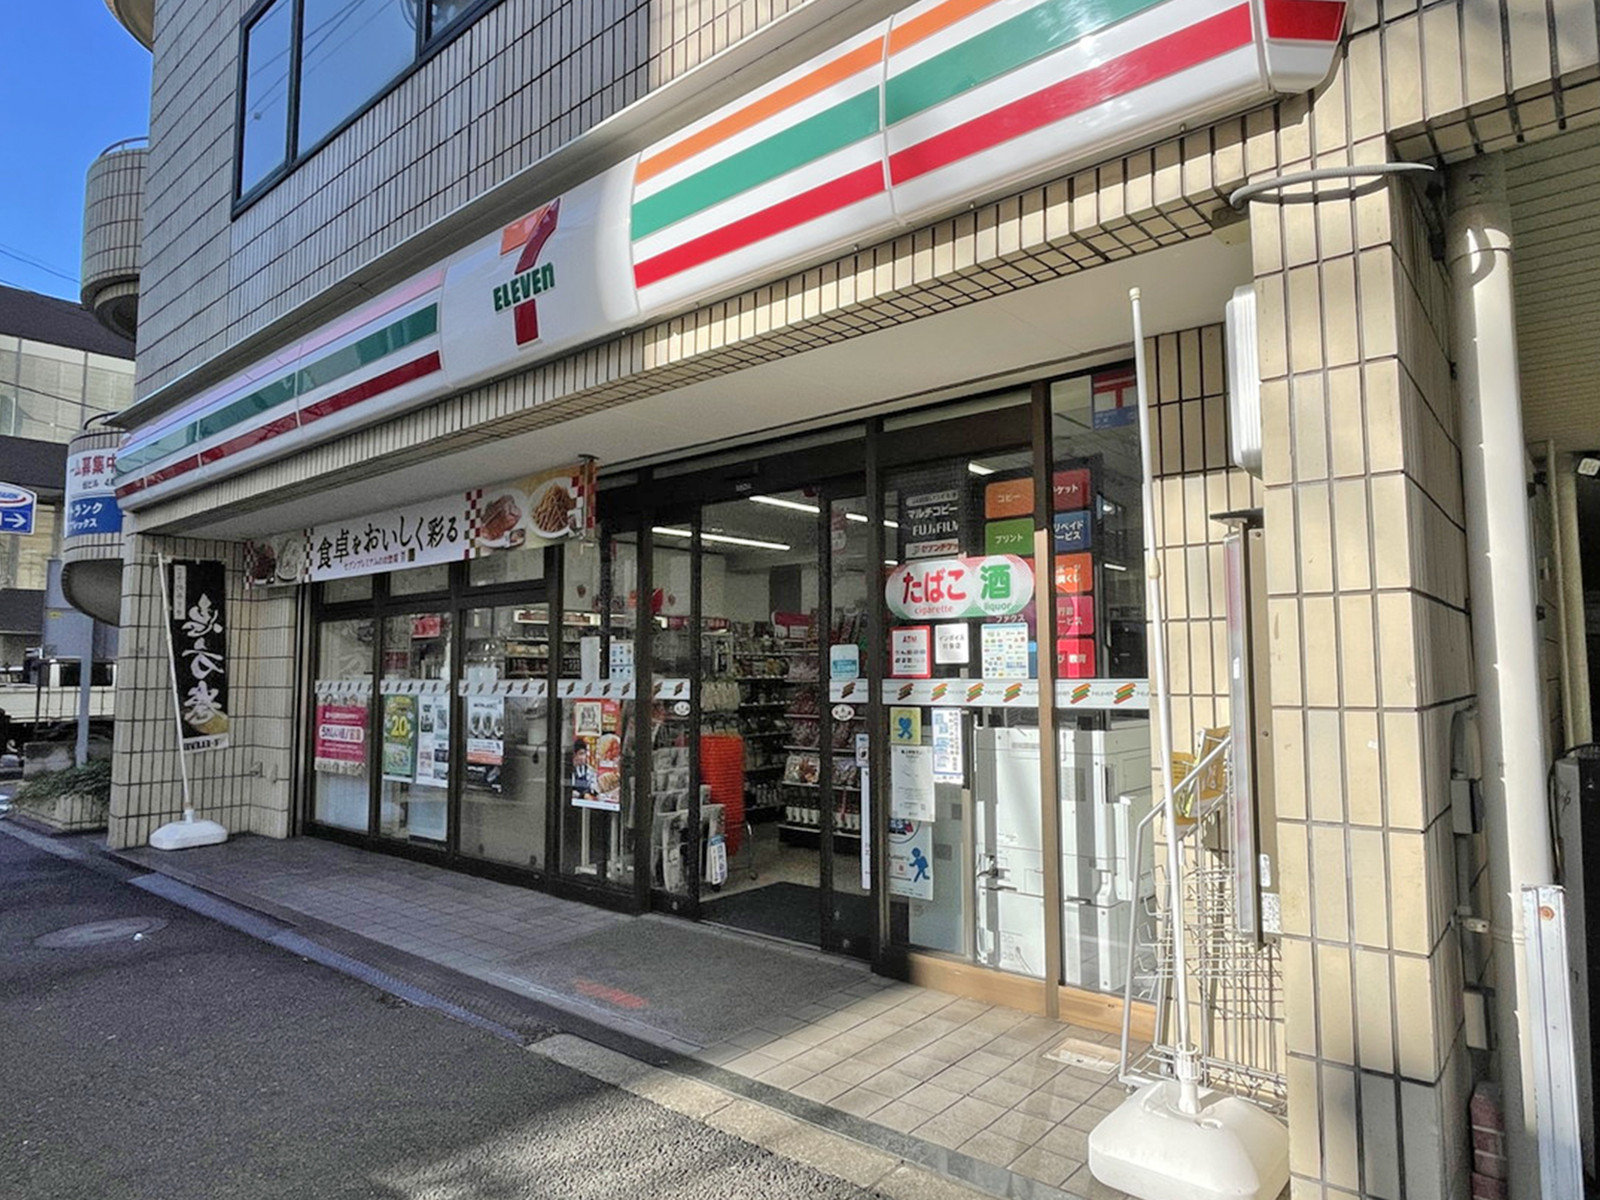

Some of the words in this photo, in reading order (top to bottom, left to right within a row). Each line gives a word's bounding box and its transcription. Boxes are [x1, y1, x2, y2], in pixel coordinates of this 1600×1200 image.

[493, 261, 555, 312] ELEVEN
[998, 494, 1021, 503] コピー
[907, 503, 958, 519] マルチコピー
[317, 515, 458, 570] 食卓をおいしく彩る
[995, 533, 1023, 544] プリント
[903, 568, 967, 604] たばこ
[980, 564, 1011, 600] 酒
[914, 605, 954, 616] cigarette
[984, 601, 1012, 613] liquor
[390, 715, 408, 737] 20
